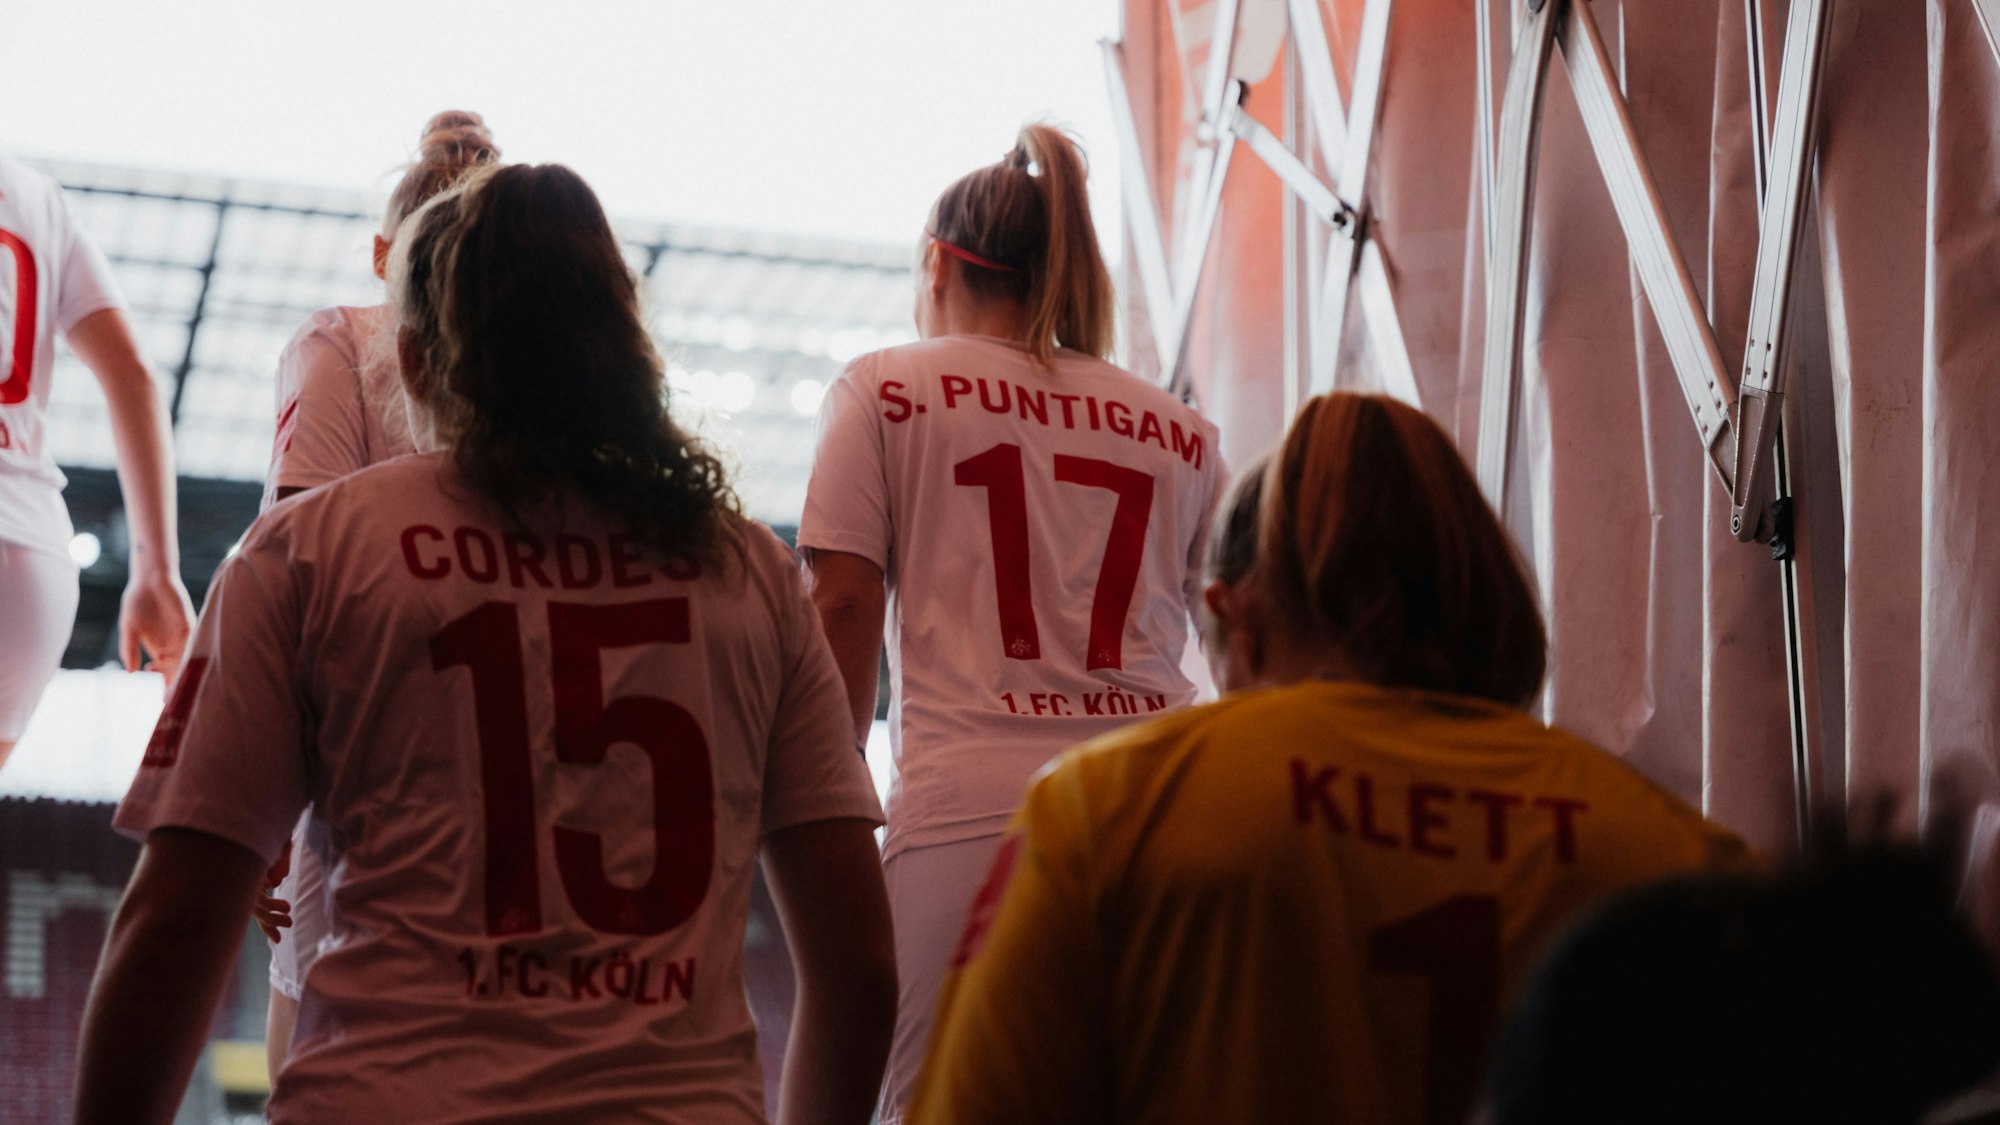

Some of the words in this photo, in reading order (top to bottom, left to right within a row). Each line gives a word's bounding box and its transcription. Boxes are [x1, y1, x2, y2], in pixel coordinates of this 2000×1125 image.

[880, 380, 927, 423] S.
[941, 374, 1203, 470] PUNTIGAM
[954, 440, 1155, 673] 17
[429, 596, 716, 937] 15
[1290, 759, 1590, 865] KLETT
[570, 949, 697, 1005] KÖLN
